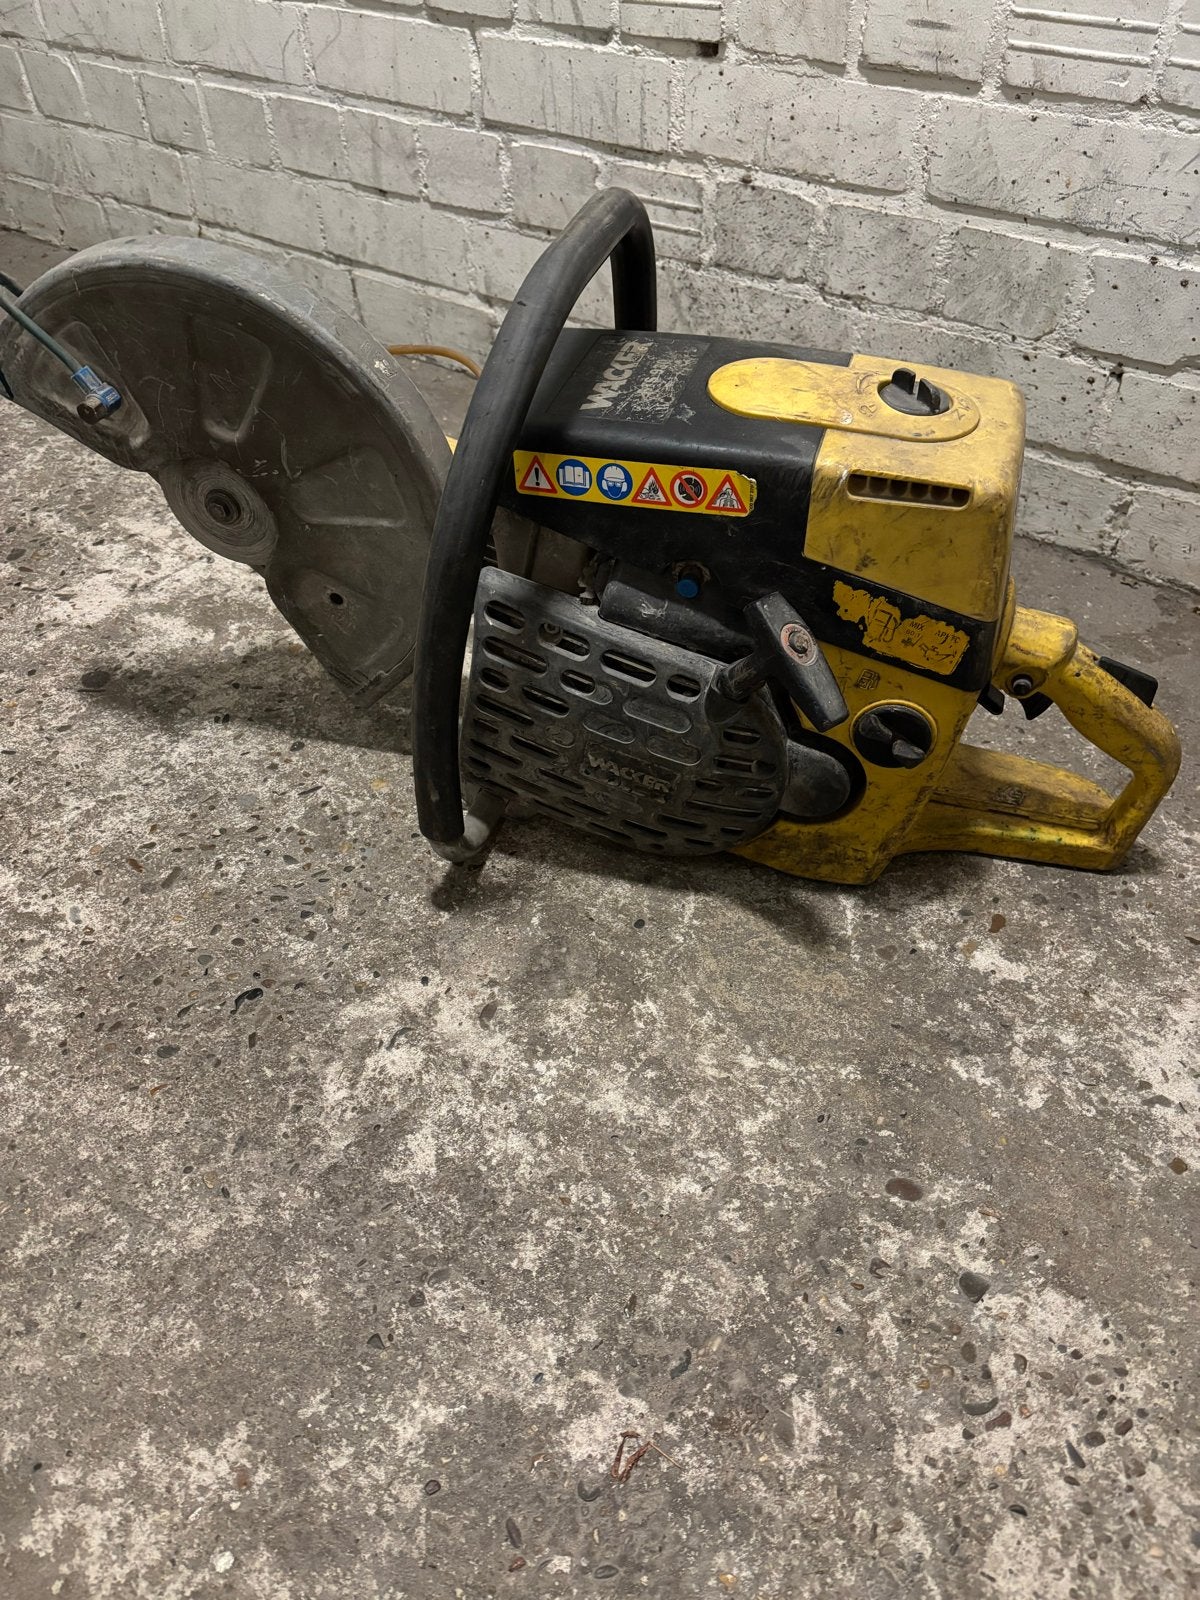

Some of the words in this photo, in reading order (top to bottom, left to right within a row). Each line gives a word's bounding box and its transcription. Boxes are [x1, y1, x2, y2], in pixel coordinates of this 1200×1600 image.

[579, 341, 654, 411] WACKER
[909, 620, 925, 632] MIX
[587, 752, 672, 793] WACKER
